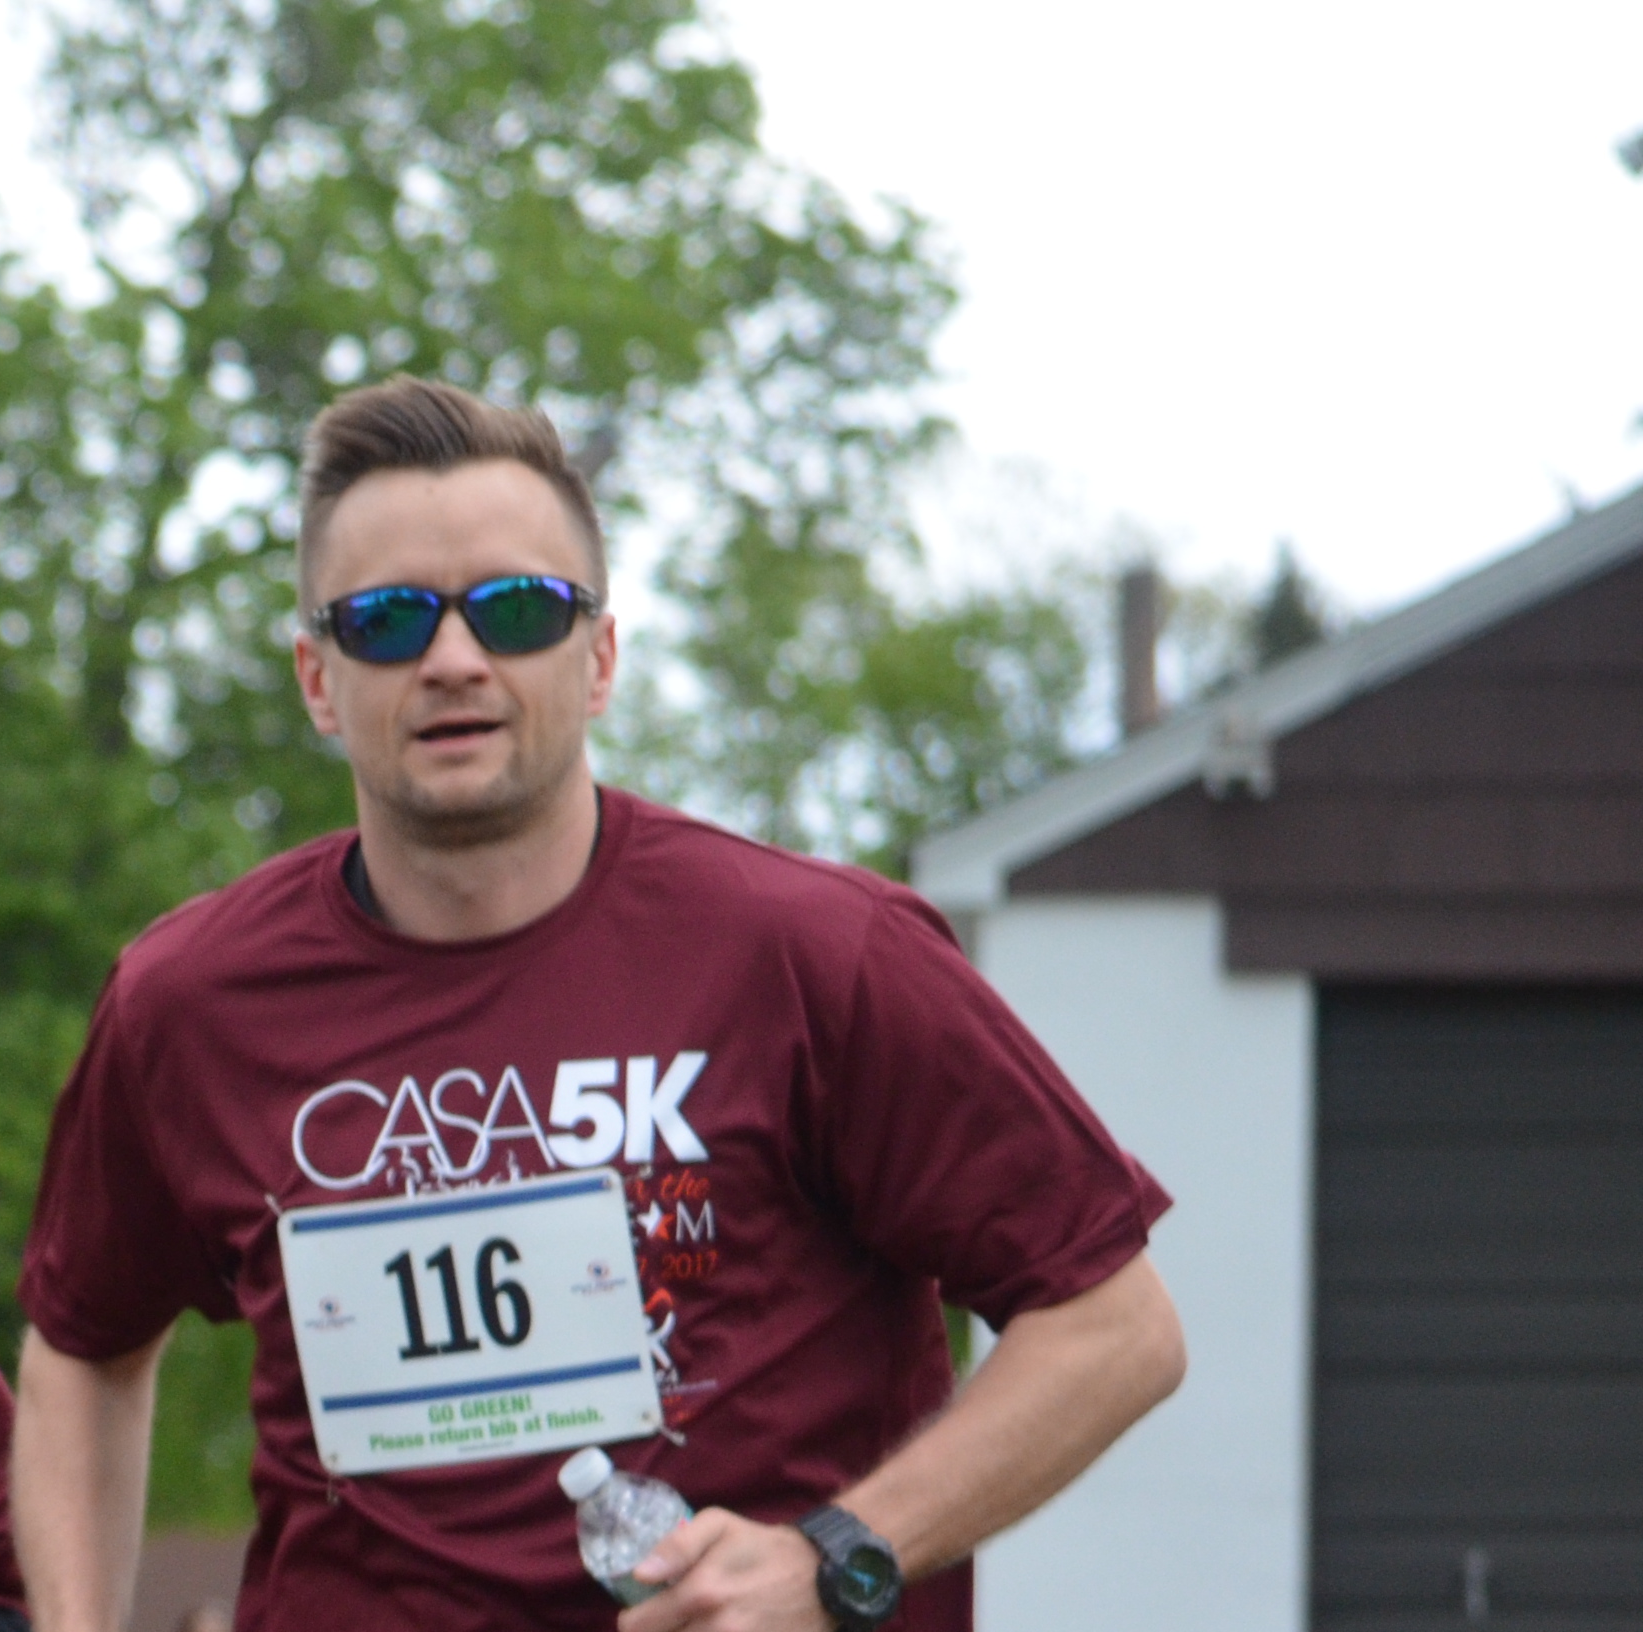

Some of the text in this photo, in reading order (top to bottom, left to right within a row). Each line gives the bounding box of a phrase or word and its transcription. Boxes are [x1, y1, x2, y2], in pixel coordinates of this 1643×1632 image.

[661, 1251, 718, 1278] 2017
[384, 1237, 533, 1360] 116
[428, 1393, 533, 1424] GO GREEN!
[369, 1433, 425, 1451] Please
[430, 1424, 484, 1445] return
[488, 1418, 518, 1438] bib
[524, 1415, 542, 1433] at
